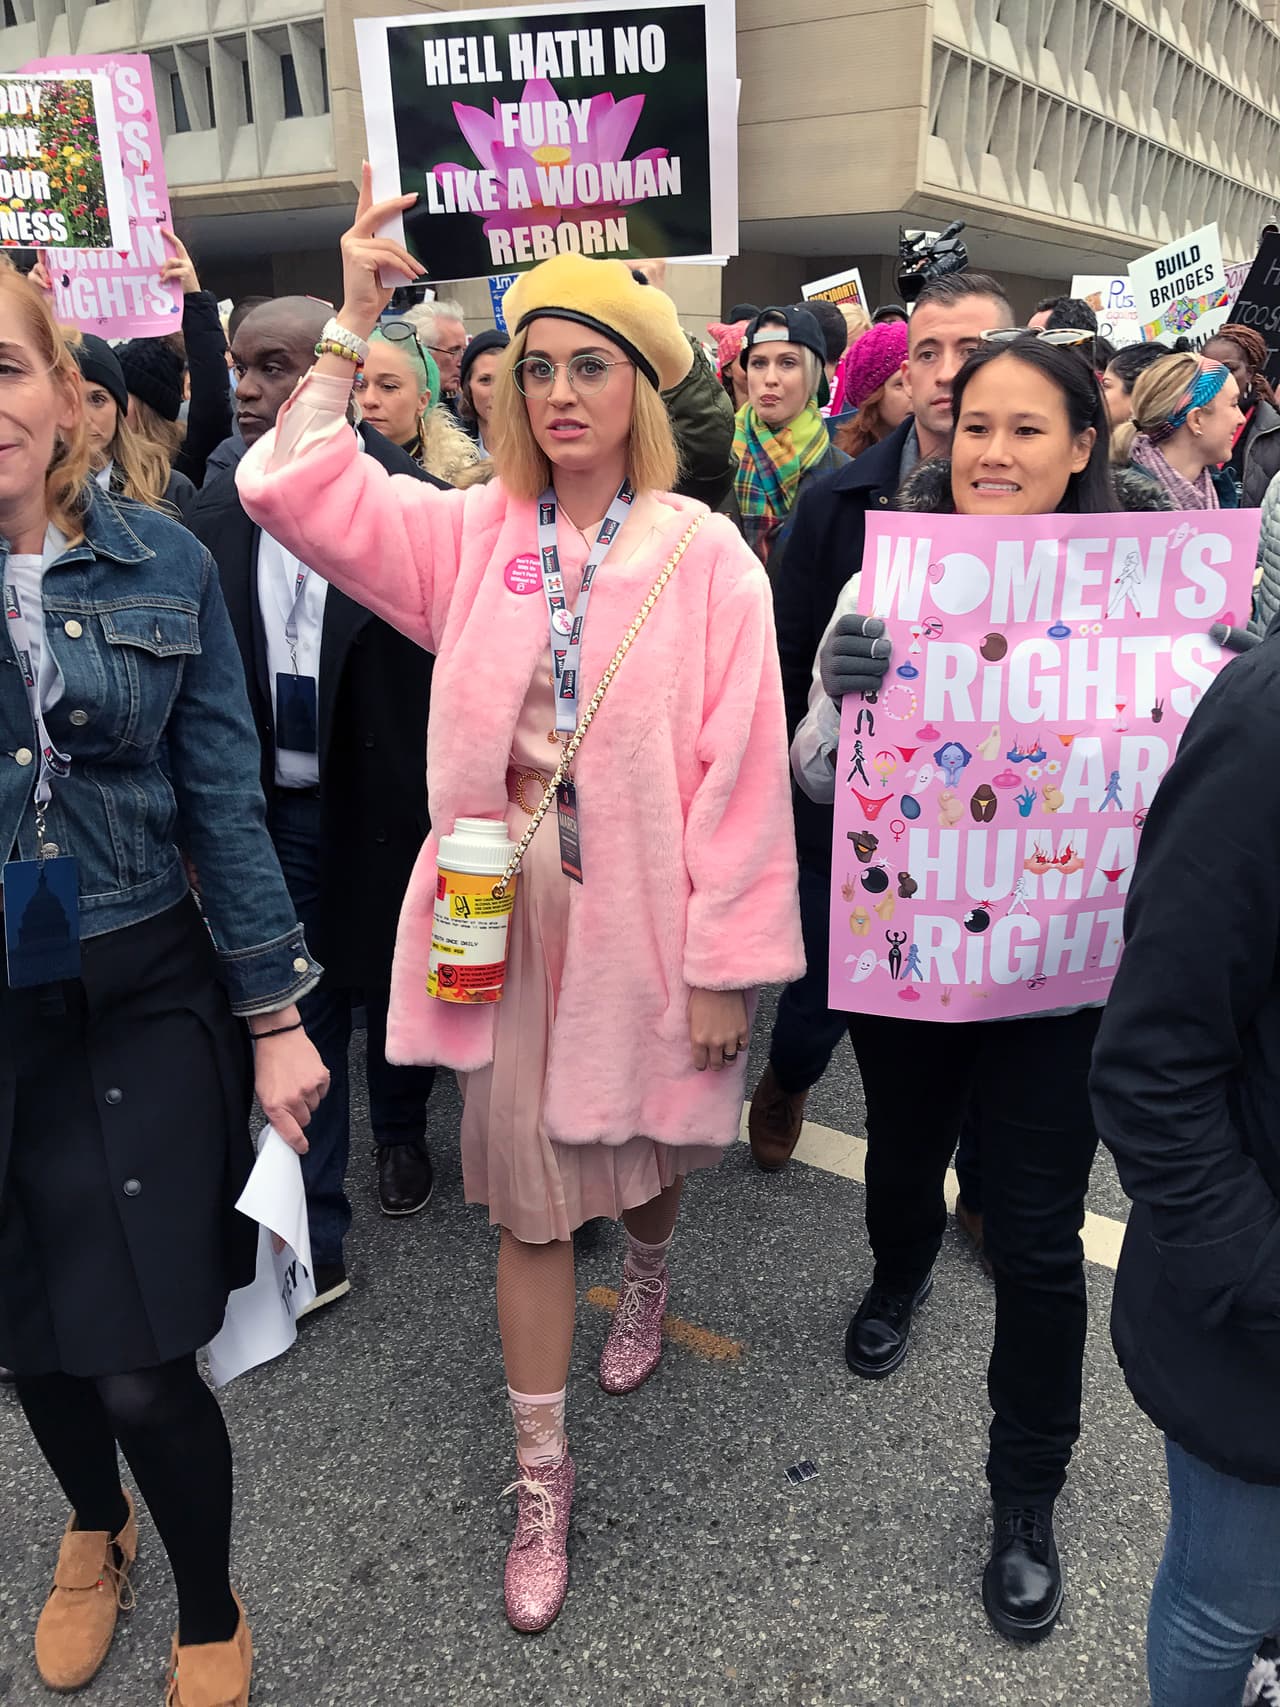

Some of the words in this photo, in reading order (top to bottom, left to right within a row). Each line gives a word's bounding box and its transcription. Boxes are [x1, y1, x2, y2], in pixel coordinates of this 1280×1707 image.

[423, 35, 503, 86] HELL
[508, 28, 605, 81] HATH
[613, 24, 666, 75] NO
[500, 98, 592, 148] FURY
[425, 169, 501, 215] LIKE
[507, 167, 533, 210] A
[535, 156, 682, 207] WOMAN
[0, 210, 68, 242] NESS
[487, 216, 630, 266] REBORN
[1150, 264, 1214, 308] BRIDGES
[1155, 245, 1201, 280] BUILD
[870, 532, 1232, 624] WOMEN'S
[1056, 734, 1182, 814] AR
[906, 827, 1135, 902] HUMA
[910, 908, 1125, 987] RiGHT
